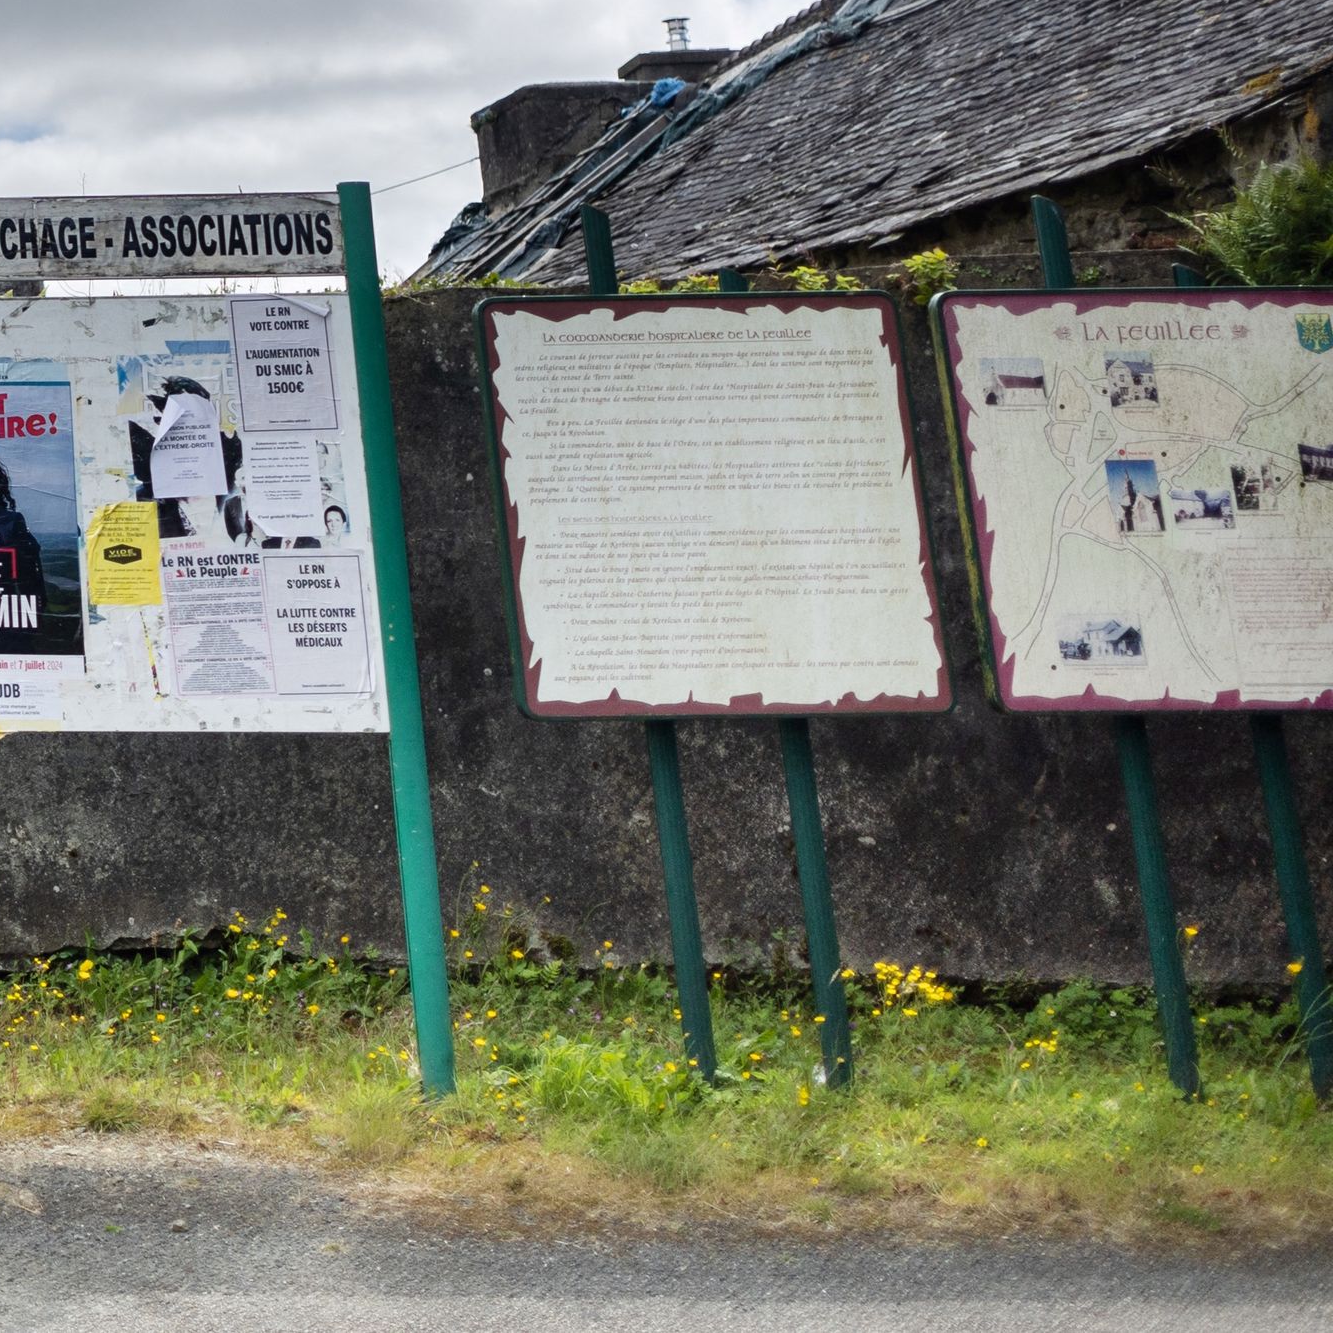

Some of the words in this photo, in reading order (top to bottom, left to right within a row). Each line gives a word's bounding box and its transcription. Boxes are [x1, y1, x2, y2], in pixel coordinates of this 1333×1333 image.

[122, 211, 333, 258] ASSOCIATIONS
[266, 307, 275, 316] LE
[278, 307, 291, 316] RN
[250, 321, 272, 331] VOTE
[274, 320, 309, 330] CONTRE
[245, 348, 319, 359] L'AUGMENTATION
[256, 366, 271, 376] DU
[275, 364, 302, 376] SMIC
[306, 361, 313, 375] À
[268, 382, 304, 394] 1500€
[162, 558, 173, 567] Le
[178, 556, 193, 566] RN
[197, 556, 214, 566] est
[217, 553, 260, 565] CONTRE
[186, 568, 197, 578] le
[200, 566, 238, 578] Peuple
[299, 565, 309, 574] LE
[312, 564, 325, 574] RN
[287, 579, 332, 589] S'OPPOSE
[334, 576, 340, 588] À
[277, 608, 288, 618] LA
[291, 608, 317, 618] LUTTE
[320, 608, 356, 618] CONTRE
[288, 623, 304, 632] LES
[307, 621, 347, 632] DÉSERTS
[295, 635, 343, 647] MÉDICAUX
[10, 661, 16, 669] et
[19, 660, 23, 669] 7
[24, 660, 45, 671] juillet
[47, 661, 63, 670] 2024
